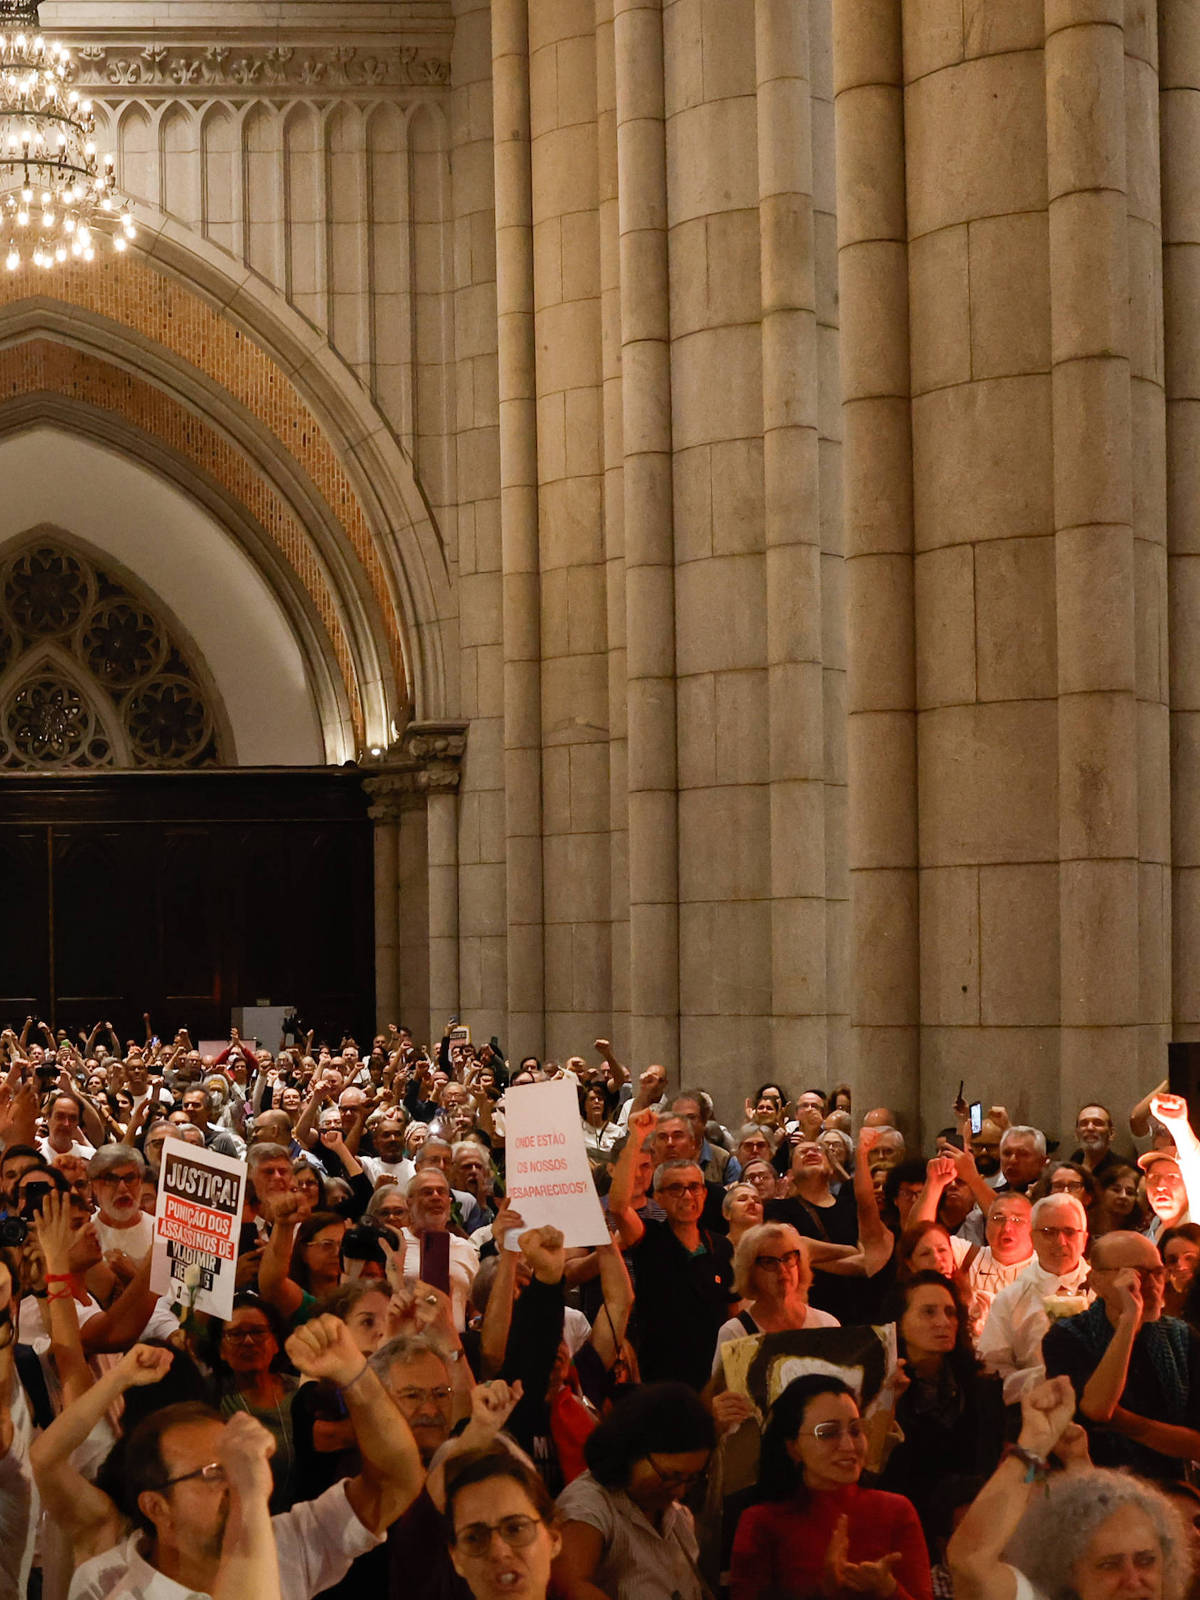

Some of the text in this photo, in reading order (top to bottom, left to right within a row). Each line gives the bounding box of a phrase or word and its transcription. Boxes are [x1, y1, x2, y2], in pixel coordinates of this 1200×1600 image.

[515, 1135, 535, 1149] ONDE
[517, 1158, 568, 1173] OS NOSSOS
[166, 1163, 238, 1208] JUSTIÇA!
[167, 1200, 230, 1235] PUNIÇÃO DOS
[160, 1220, 232, 1258] ASSASSINOS DE
[172, 1240, 216, 1271] VLADIMIR
